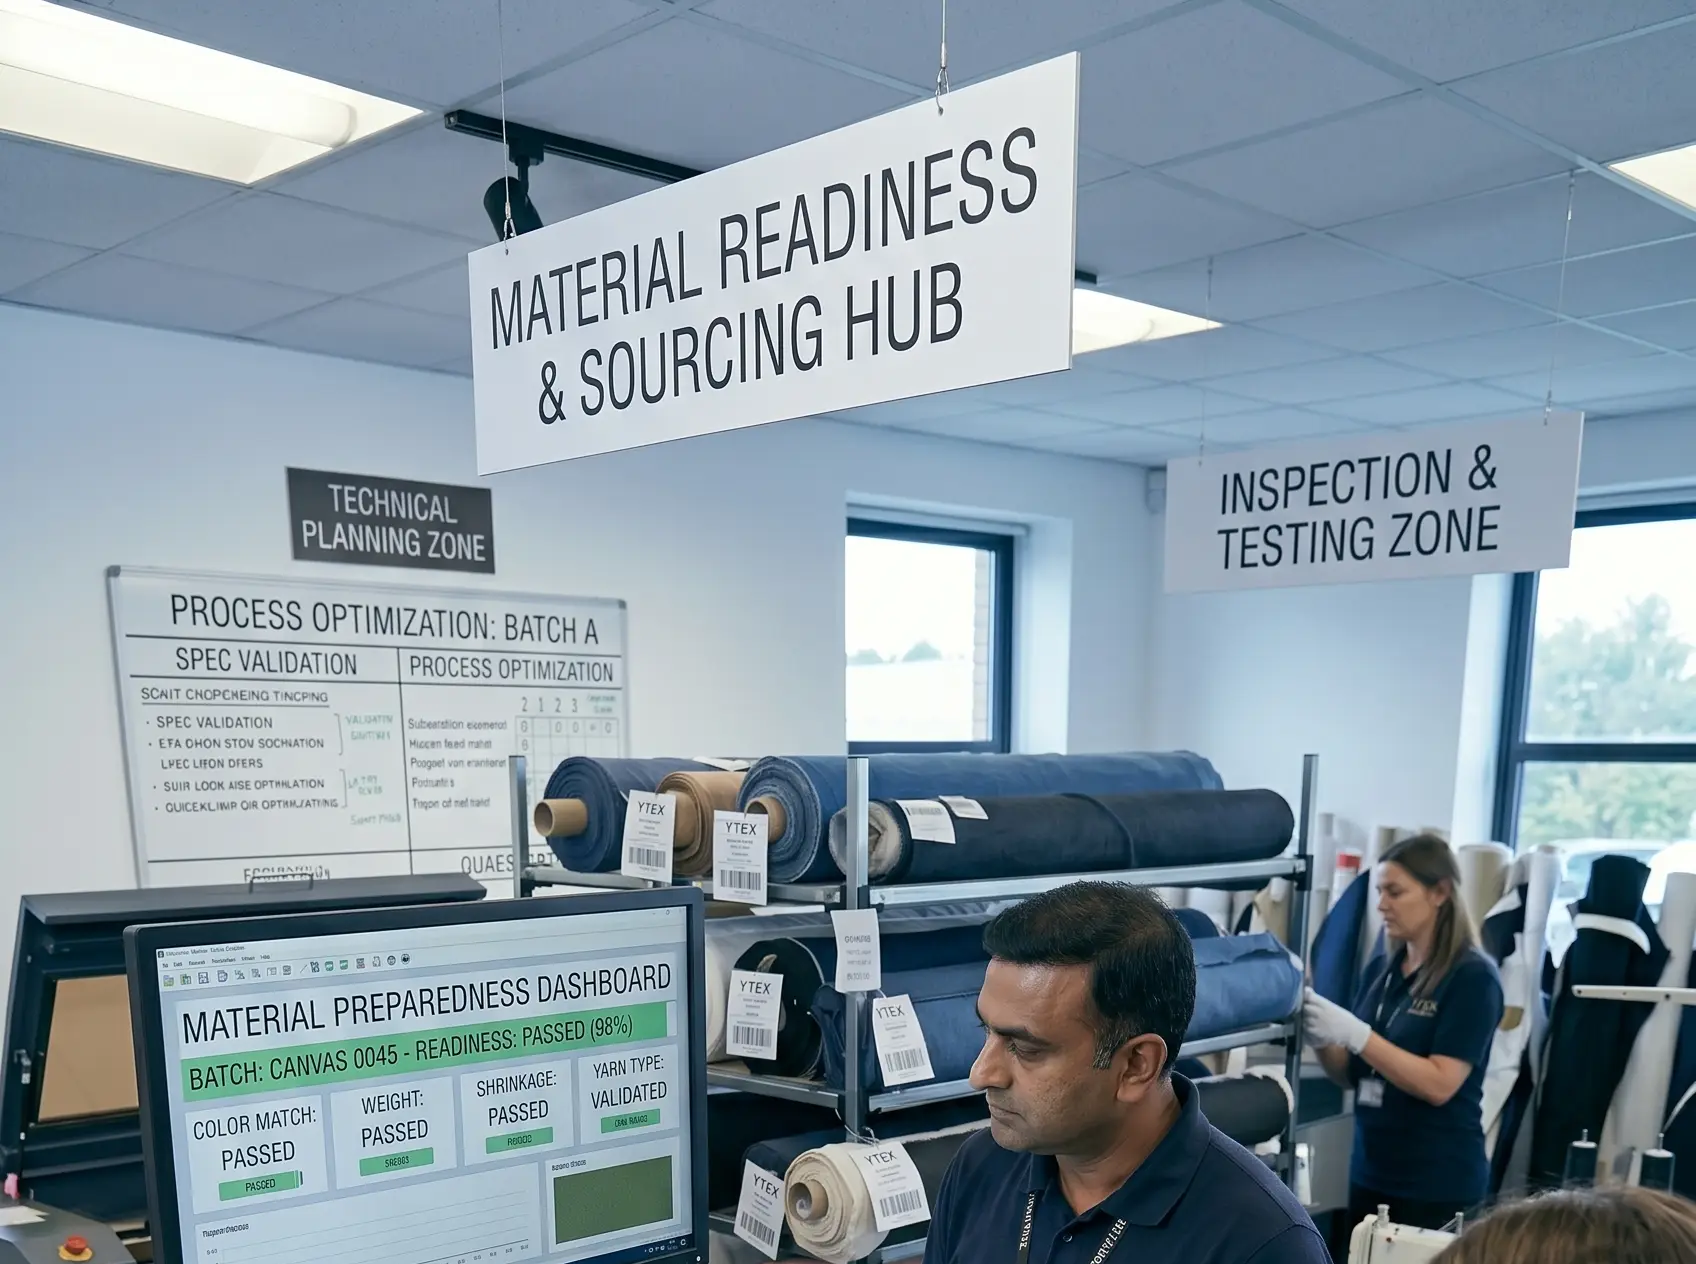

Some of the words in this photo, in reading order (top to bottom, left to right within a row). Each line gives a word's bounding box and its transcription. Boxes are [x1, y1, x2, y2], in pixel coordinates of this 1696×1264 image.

[490, 231, 702, 349] MATERIAL
[720, 126, 1038, 289] READINESS
[538, 361, 566, 425] &
[581, 295, 822, 416] SOURCING
[847, 262, 963, 361] HUB
[1220, 449, 1451, 515] INSPECTION
[1468, 444, 1497, 490] &
[327, 483, 458, 524] TECHNICAL
[302, 520, 421, 558] PLANNING
[428, 531, 486, 562] ZONE
[1217, 516, 1374, 569] TESTING
[1389, 505, 1501, 558] ZONE
[171, 594, 303, 631] PROCESS
[312, 602, 496, 641] OPTIMIZATION:
[504, 613, 575, 644] BATCH
[584, 617, 600, 645] A
[175, 647, 231, 672] SPEC
[238, 649, 357, 675] VALIDATION
[410, 655, 492, 679] PROCESS
[498, 658, 613, 682] OPTIMIZATION
[157, 716, 192, 729] SPEC
[196, 716, 273, 729] VALIDATION
[638, 802, 665, 816] YTEX
[726, 822, 757, 836] YTEX
[740, 980, 771, 995] YTEX
[182, 1001, 326, 1044] MATERIAL
[334, 976, 530, 1027] PREPAREDNESS
[537, 963, 671, 1003] DASHBOARD
[876, 1005, 904, 1020] YTEX
[189, 1060, 264, 1091] BATCH:
[269, 1050, 348, 1080] CANVAS
[353, 1043, 399, 1070] 0045
[415, 1028, 518, 1062] READINESS:
[522, 1021, 585, 1049] PASSED
[589, 1014, 634, 1044] (98%)
[593, 1060, 627, 1080] YARN
[630, 1055, 665, 1074] TYPE:
[477, 1071, 557, 1098] SHRINKAGE:
[590, 1081, 668, 1111] VALIDATED
[361, 1090, 424, 1116] WEIGHT:
[488, 1100, 549, 1127] PASSED
[193, 1115, 251, 1141] COLOR
[256, 1107, 317, 1132] MATCH:
[361, 1119, 429, 1149] PASSED
[221, 1140, 296, 1171] PASSED
[864, 1150, 897, 1166] YTEX
[753, 1173, 780, 1199] YTEX
